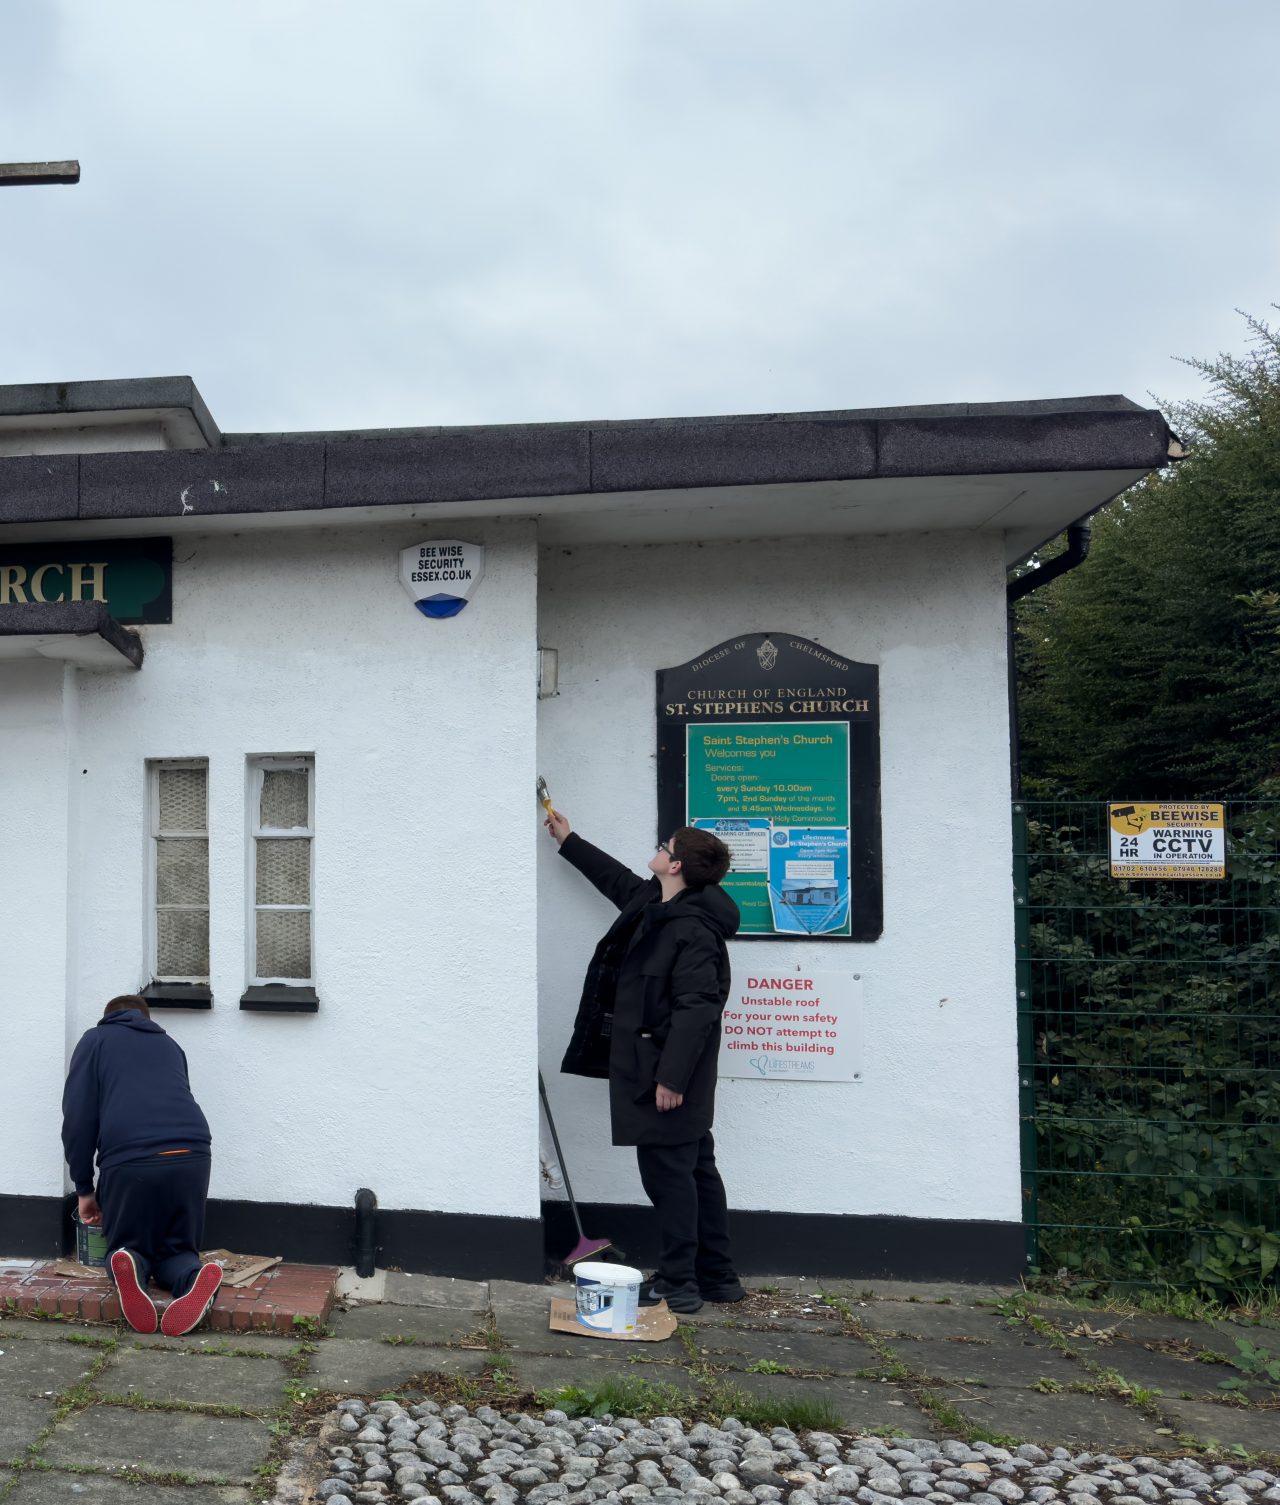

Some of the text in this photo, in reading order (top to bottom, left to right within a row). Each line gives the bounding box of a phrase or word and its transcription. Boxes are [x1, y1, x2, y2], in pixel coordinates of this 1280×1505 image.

[420, 546, 463, 557] BEE WISE
[418, 558, 464, 569] SECURITY
[411, 570, 472, 582] ESSEX.CO.UK
[692, 641, 849, 672] DIOCESE OF CHELMSFORD
[687, 687, 847, 700] CHURCH OF ENGLAND
[665, 699, 870, 715] ST. STEPHENS CHURCH
[703, 734, 833, 747] Saint Stephen's Church
[704, 749, 776, 760] Welcomes you
[705, 764, 744, 772] Services:
[711, 774, 736, 782] Doors
[716, 784, 812, 793] every Sunday 10.00am
[760, 795, 787, 803] Sunday
[1150, 811, 1219, 821] BEEWISE
[1153, 829, 1213, 838] WARNING
[1120, 837, 1138, 847] 24
[1152, 839, 1213, 853] CCTV
[1120, 848, 1138, 857] HR
[747, 977, 814, 991] DANGER
[741, 996, 821, 1007] Unstable roof
[723, 1010, 838, 1025] For your own safety
[724, 1025, 837, 1039] DO NOT attempt to
[727, 1040, 835, 1055] climb this building
